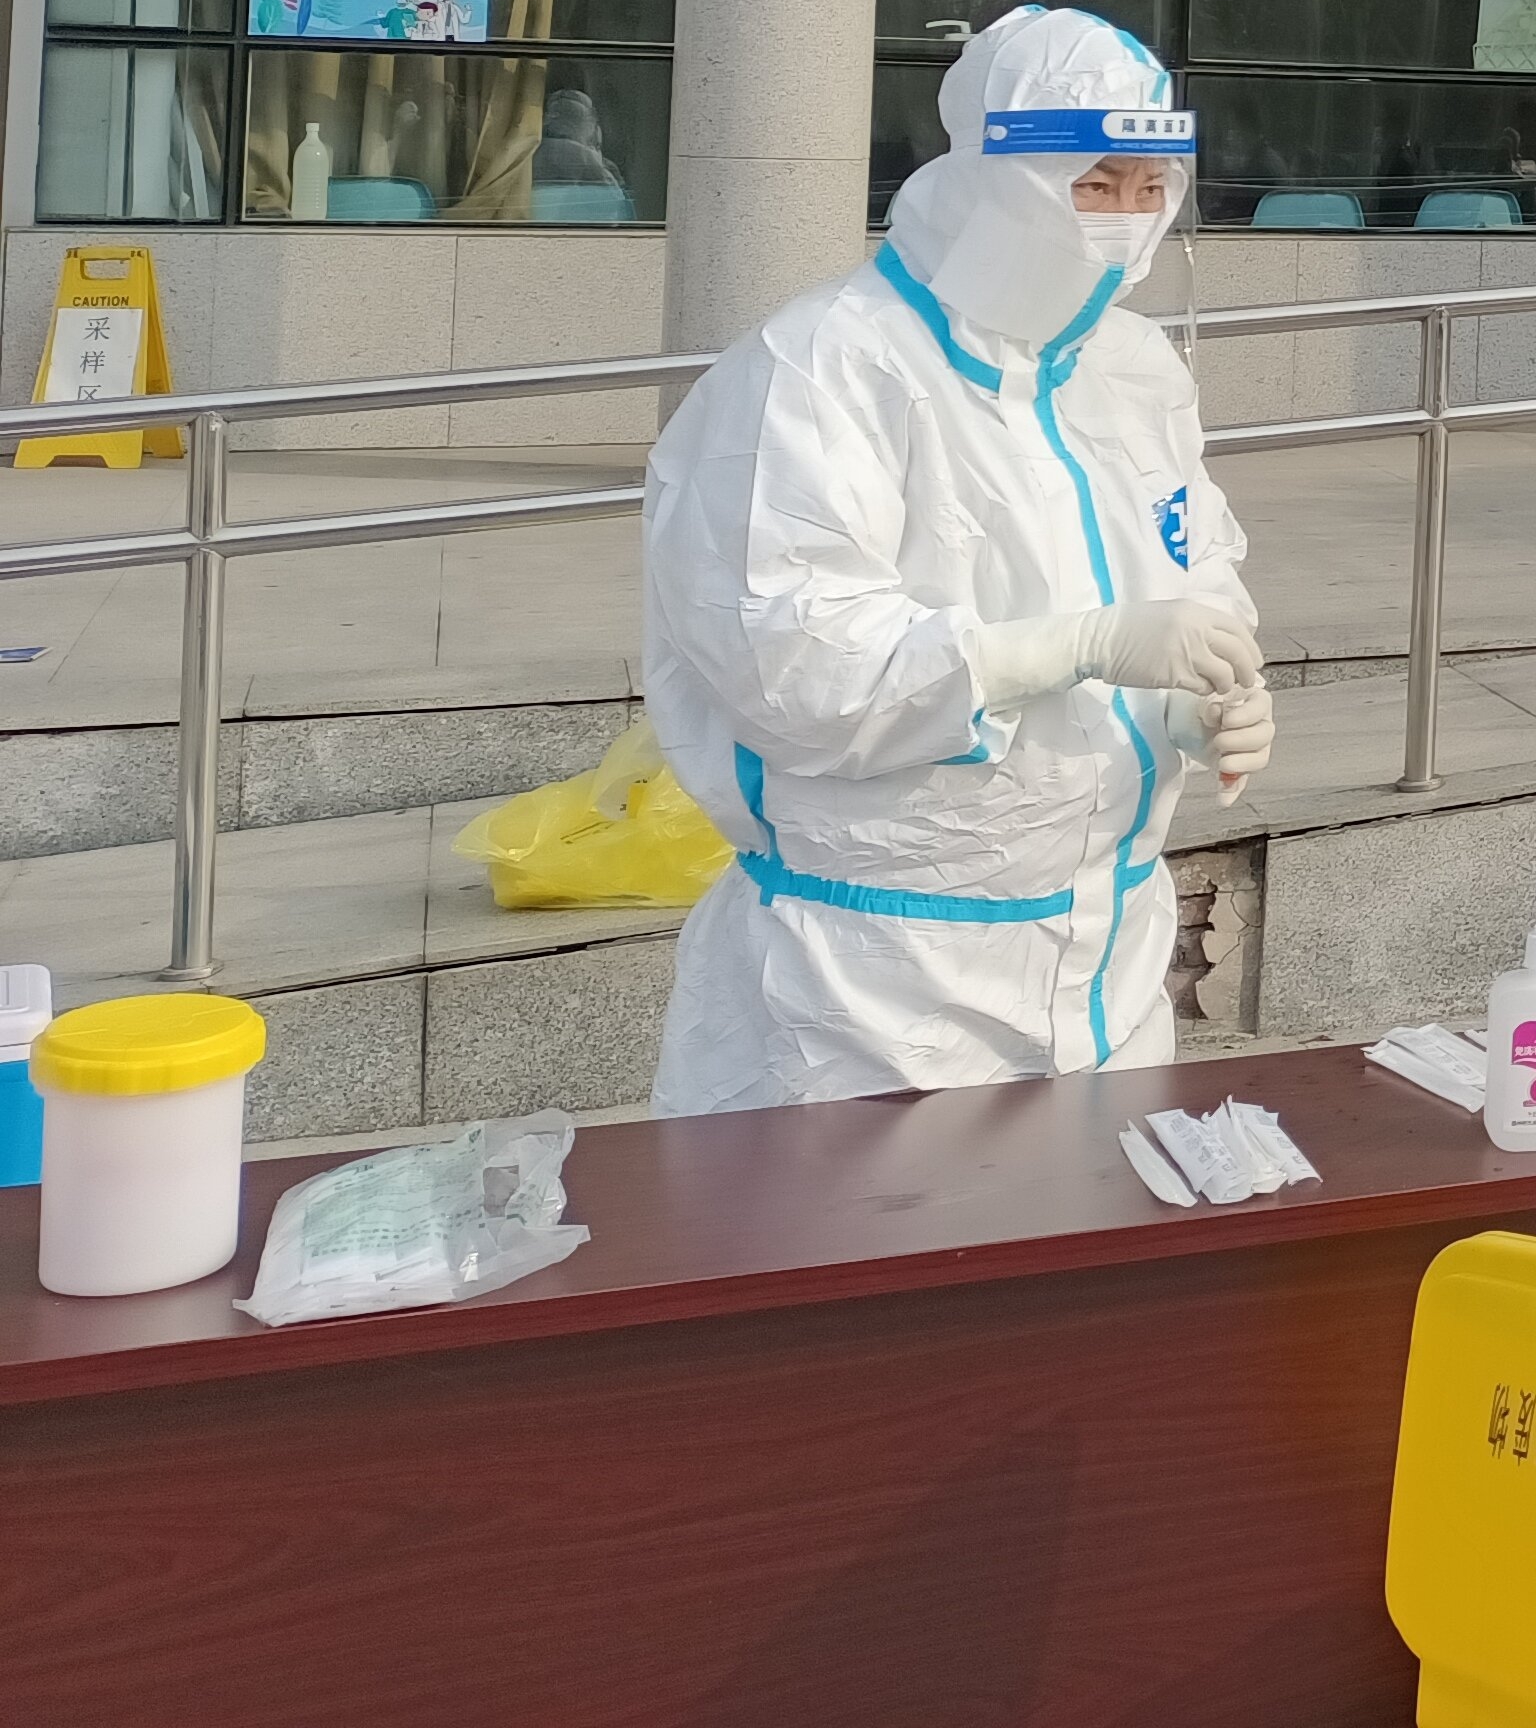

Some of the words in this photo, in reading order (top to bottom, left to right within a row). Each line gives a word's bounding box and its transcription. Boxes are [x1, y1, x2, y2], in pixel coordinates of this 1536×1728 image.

[73, 295, 130, 307] CAUTION
[77, 316, 110, 401] 采样区
